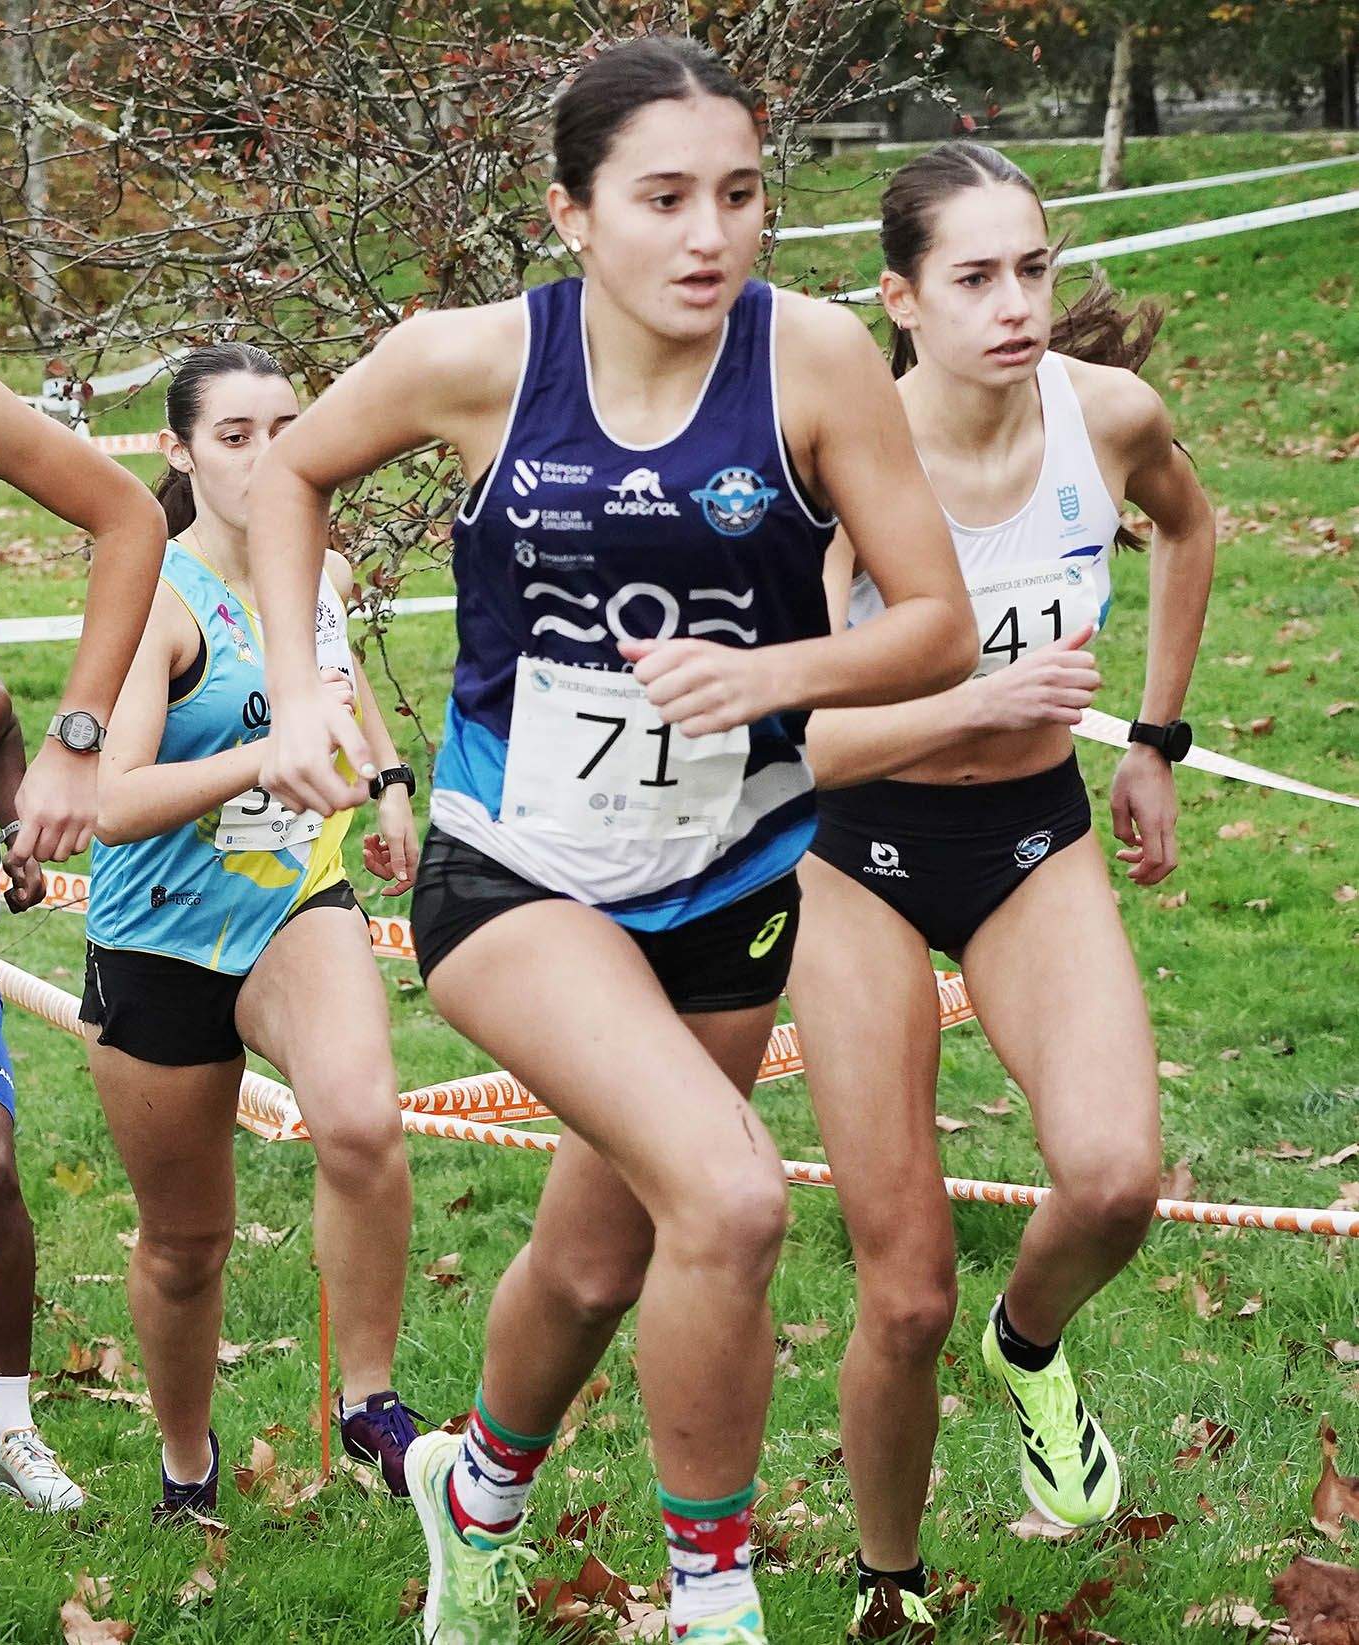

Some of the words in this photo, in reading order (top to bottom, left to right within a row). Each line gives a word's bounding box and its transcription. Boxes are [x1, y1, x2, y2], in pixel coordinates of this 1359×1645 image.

[982, 599, 1062, 665] 41
[575, 712, 679, 787] 71
[175, 897, 202, 906] LUGO
